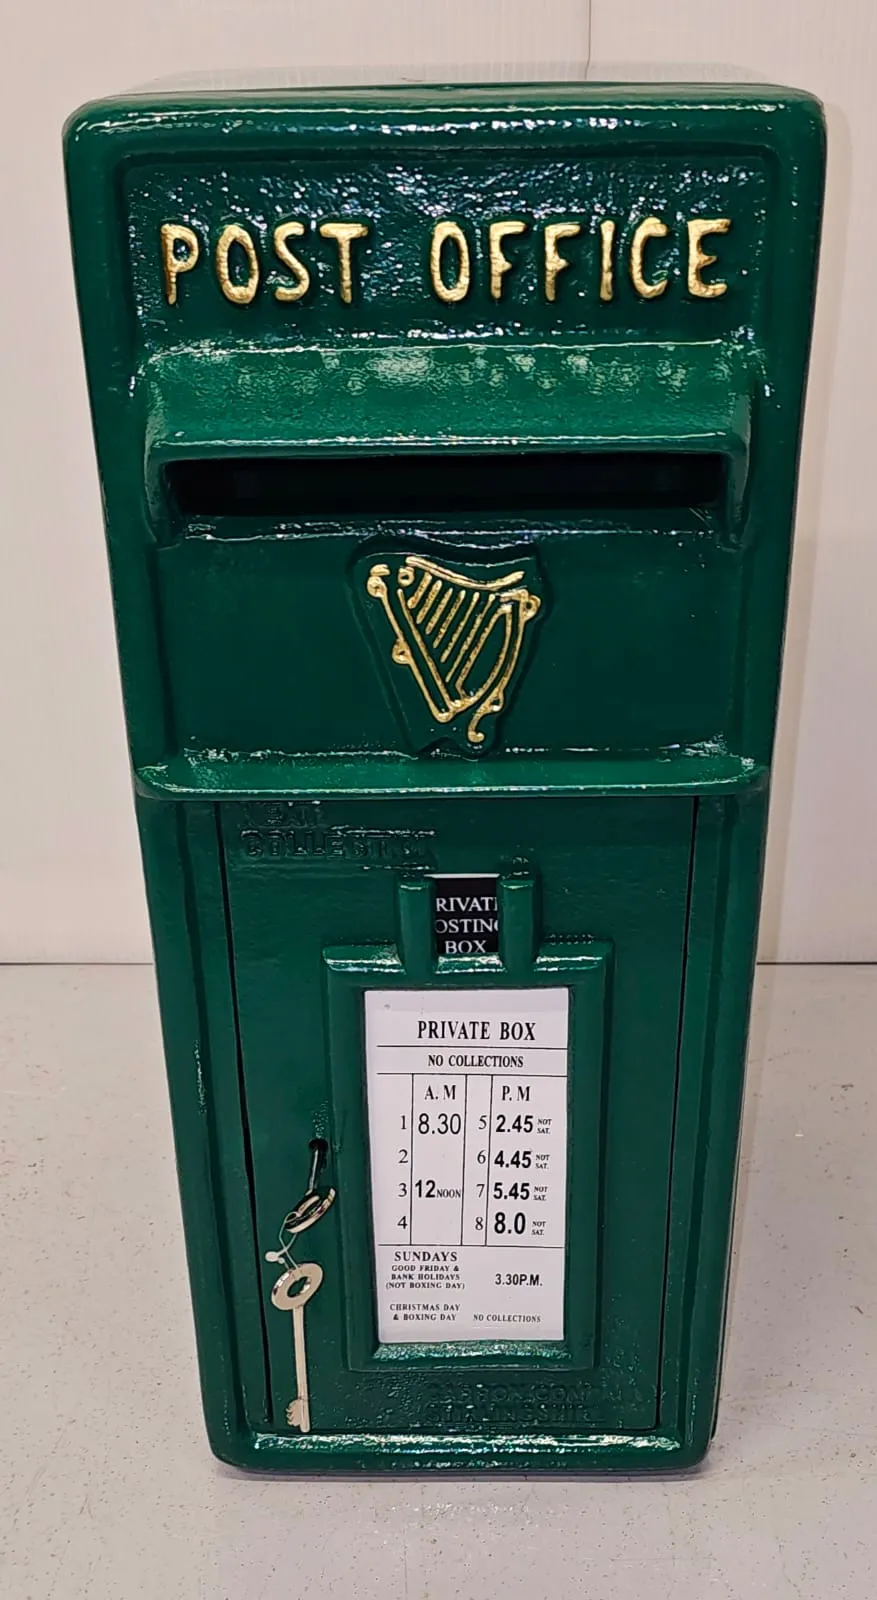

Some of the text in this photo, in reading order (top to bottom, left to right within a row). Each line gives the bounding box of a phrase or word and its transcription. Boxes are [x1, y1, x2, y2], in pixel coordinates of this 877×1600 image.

[160, 218, 732, 305] POST OFFICE
[436, 897, 498, 912] RIVAT
[435, 918, 498, 933] OSTIN
[445, 940, 487, 954] BOX
[417, 1020, 537, 1041] PRIVATE BOX
[427, 1054, 524, 1069] NO COLLECTIONS
[400, 1112, 462, 1135] 1 8.30
[478, 1113, 534, 1134] 5 2.45
[537, 1118, 553, 1126] NOT
[398, 1148, 409, 1164] 2
[476, 1149, 533, 1169] 6 4.45
[535, 1154, 551, 1162] NOT
[397, 1182, 408, 1198] 3
[475, 1181, 531, 1201] 7 5.45
[533, 1185, 549, 1193] NOT
[396, 1215, 408, 1230] 4
[474, 1211, 527, 1235] 8 8.0
[532, 1220, 547, 1228] NOT
[394, 1250, 458, 1262] SUNDAYS
[391, 1264, 460, 1272] GOOD FRIDAY &
[391, 1273, 460, 1281] BANK HOLIDAYS
[385, 1281, 465, 1290] (NOT BOXING DAY)
[389, 1303, 461, 1312] CHRISTMAS DAY
[392, 1313, 457, 1321] & BOXING DAY
[473, 1313, 541, 1323] NO COLLECTIONS
